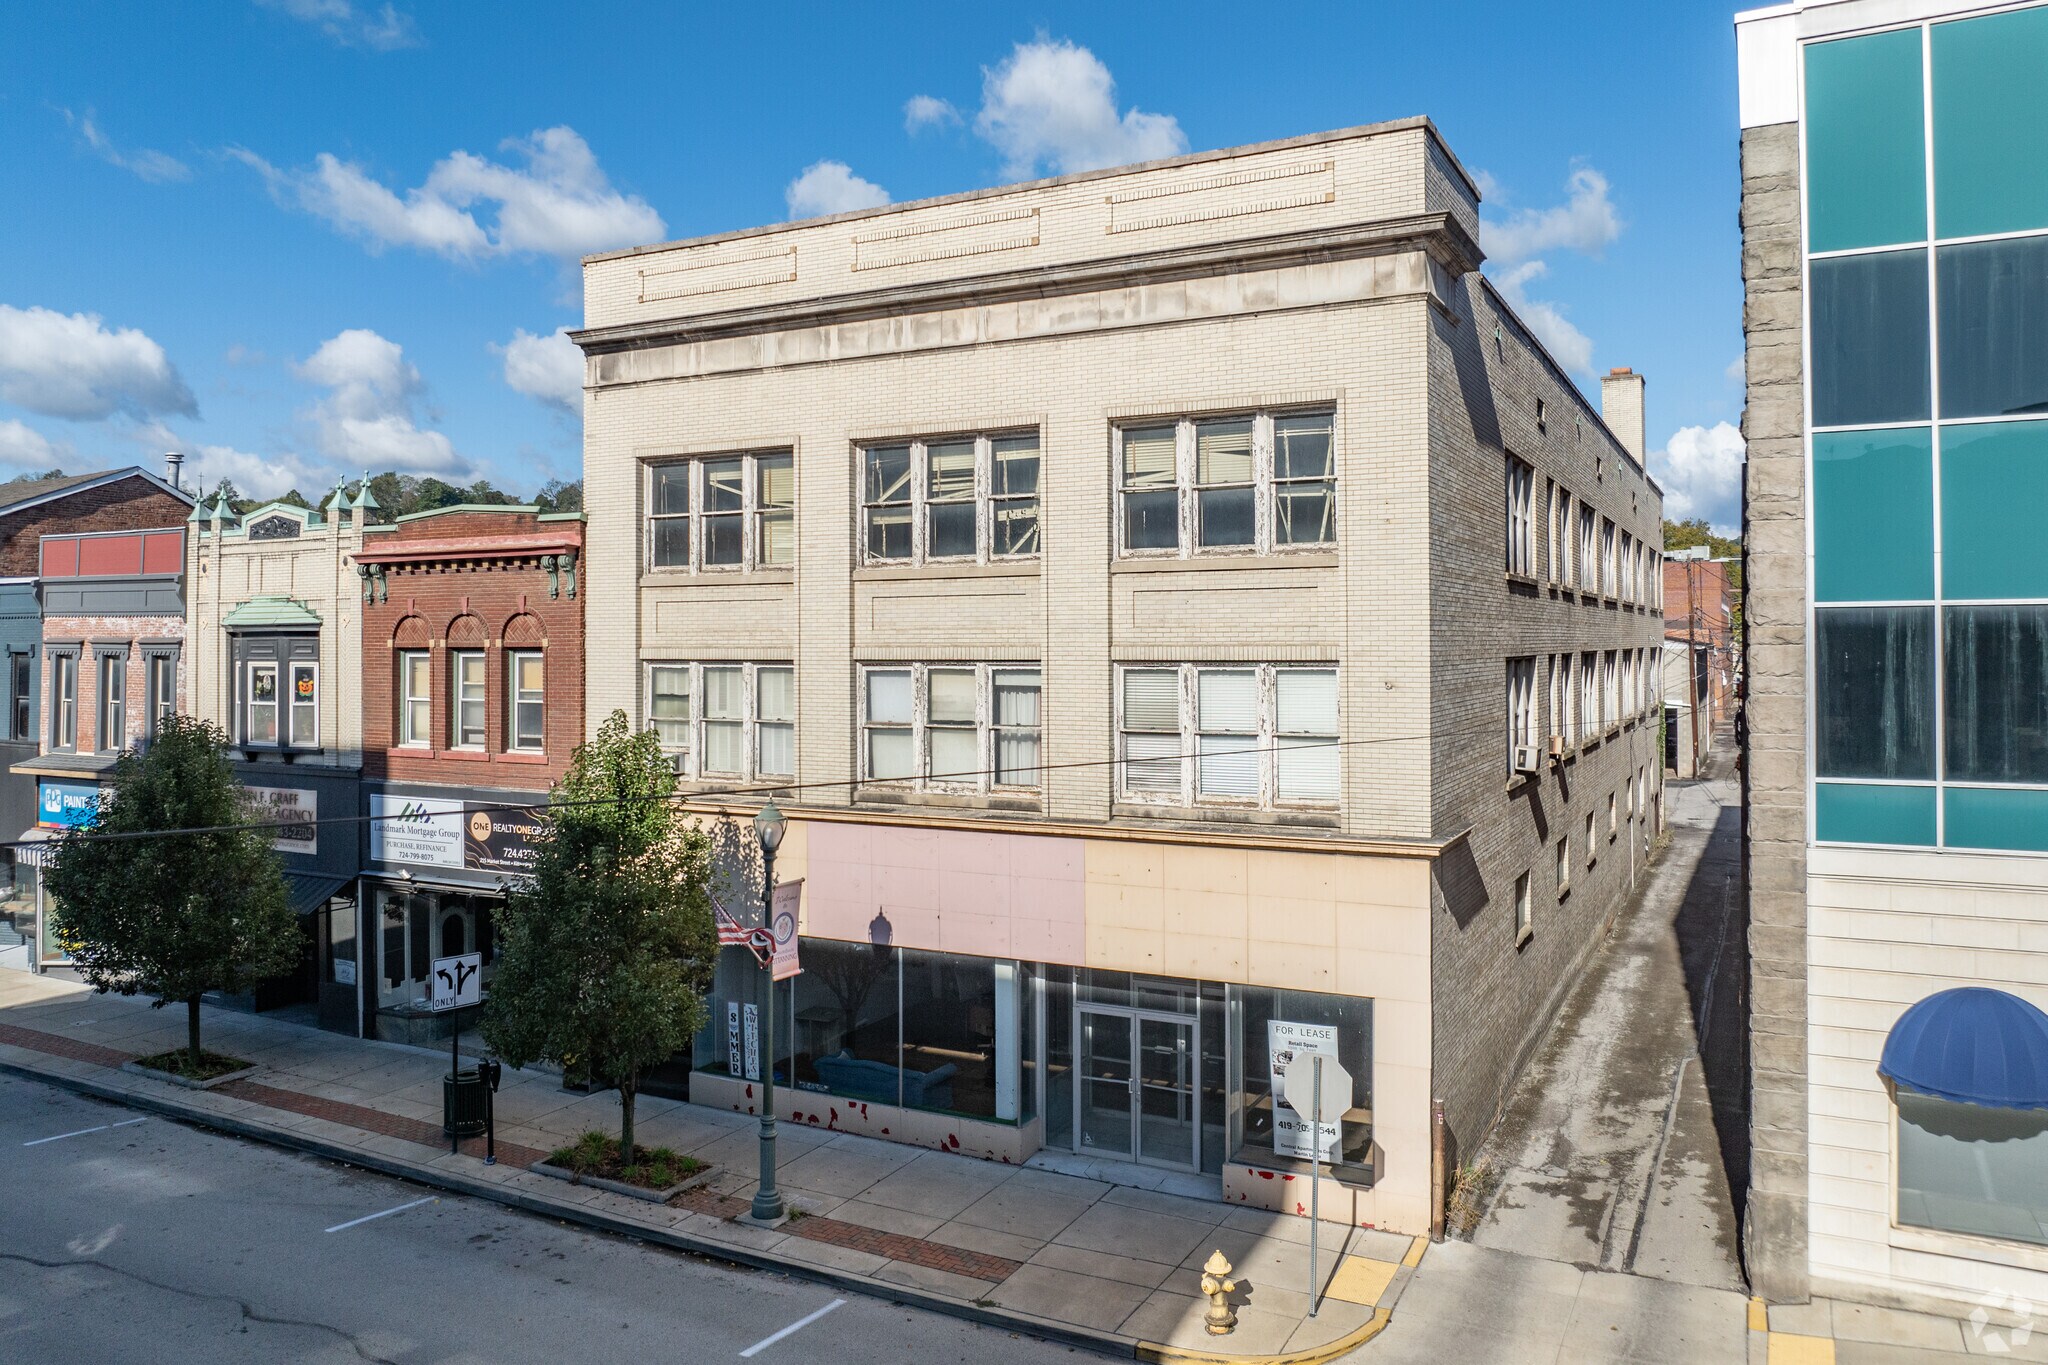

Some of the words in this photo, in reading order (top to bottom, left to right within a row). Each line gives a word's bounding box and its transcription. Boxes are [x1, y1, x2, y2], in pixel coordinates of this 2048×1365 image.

[274, 808, 313, 822] AGENCY
[374, 823, 406, 834] Landmark
[407, 826, 437, 838] Mortgage
[438, 828, 460, 840] Group
[473, 822, 489, 831] ONE
[386, 841, 415, 850] PURCHASE,
[416, 844, 447, 853] REFINANCE
[399, 851, 434, 861] 724-799-8075
[773, 952, 798, 965] ITTANNING
[435, 997, 454, 1008] ONLY
[1275, 1025, 1294, 1035] FOR
[1300, 1028, 1332, 1040] LEASE
[1280, 1142, 1297, 1150] Central
